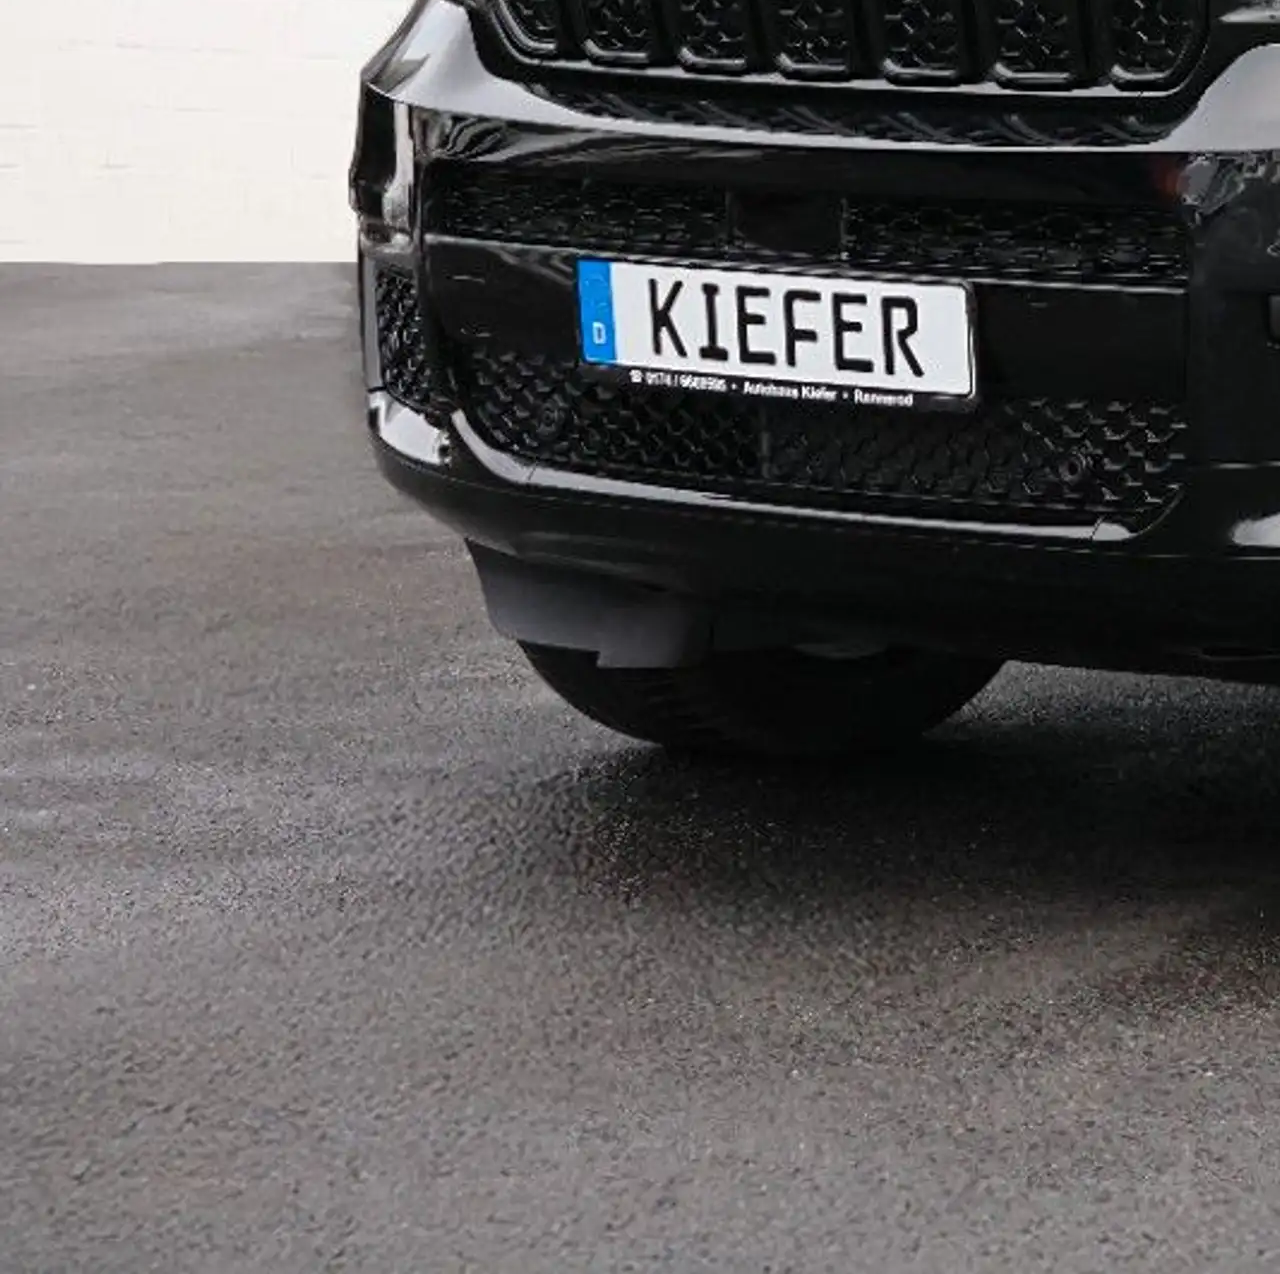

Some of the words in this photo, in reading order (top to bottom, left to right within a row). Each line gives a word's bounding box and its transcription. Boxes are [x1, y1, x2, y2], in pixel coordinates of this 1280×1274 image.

[592, 321, 606, 344] D
[648, 278, 925, 378] KIEFER
[800, 384, 837, 403] Kiefer
